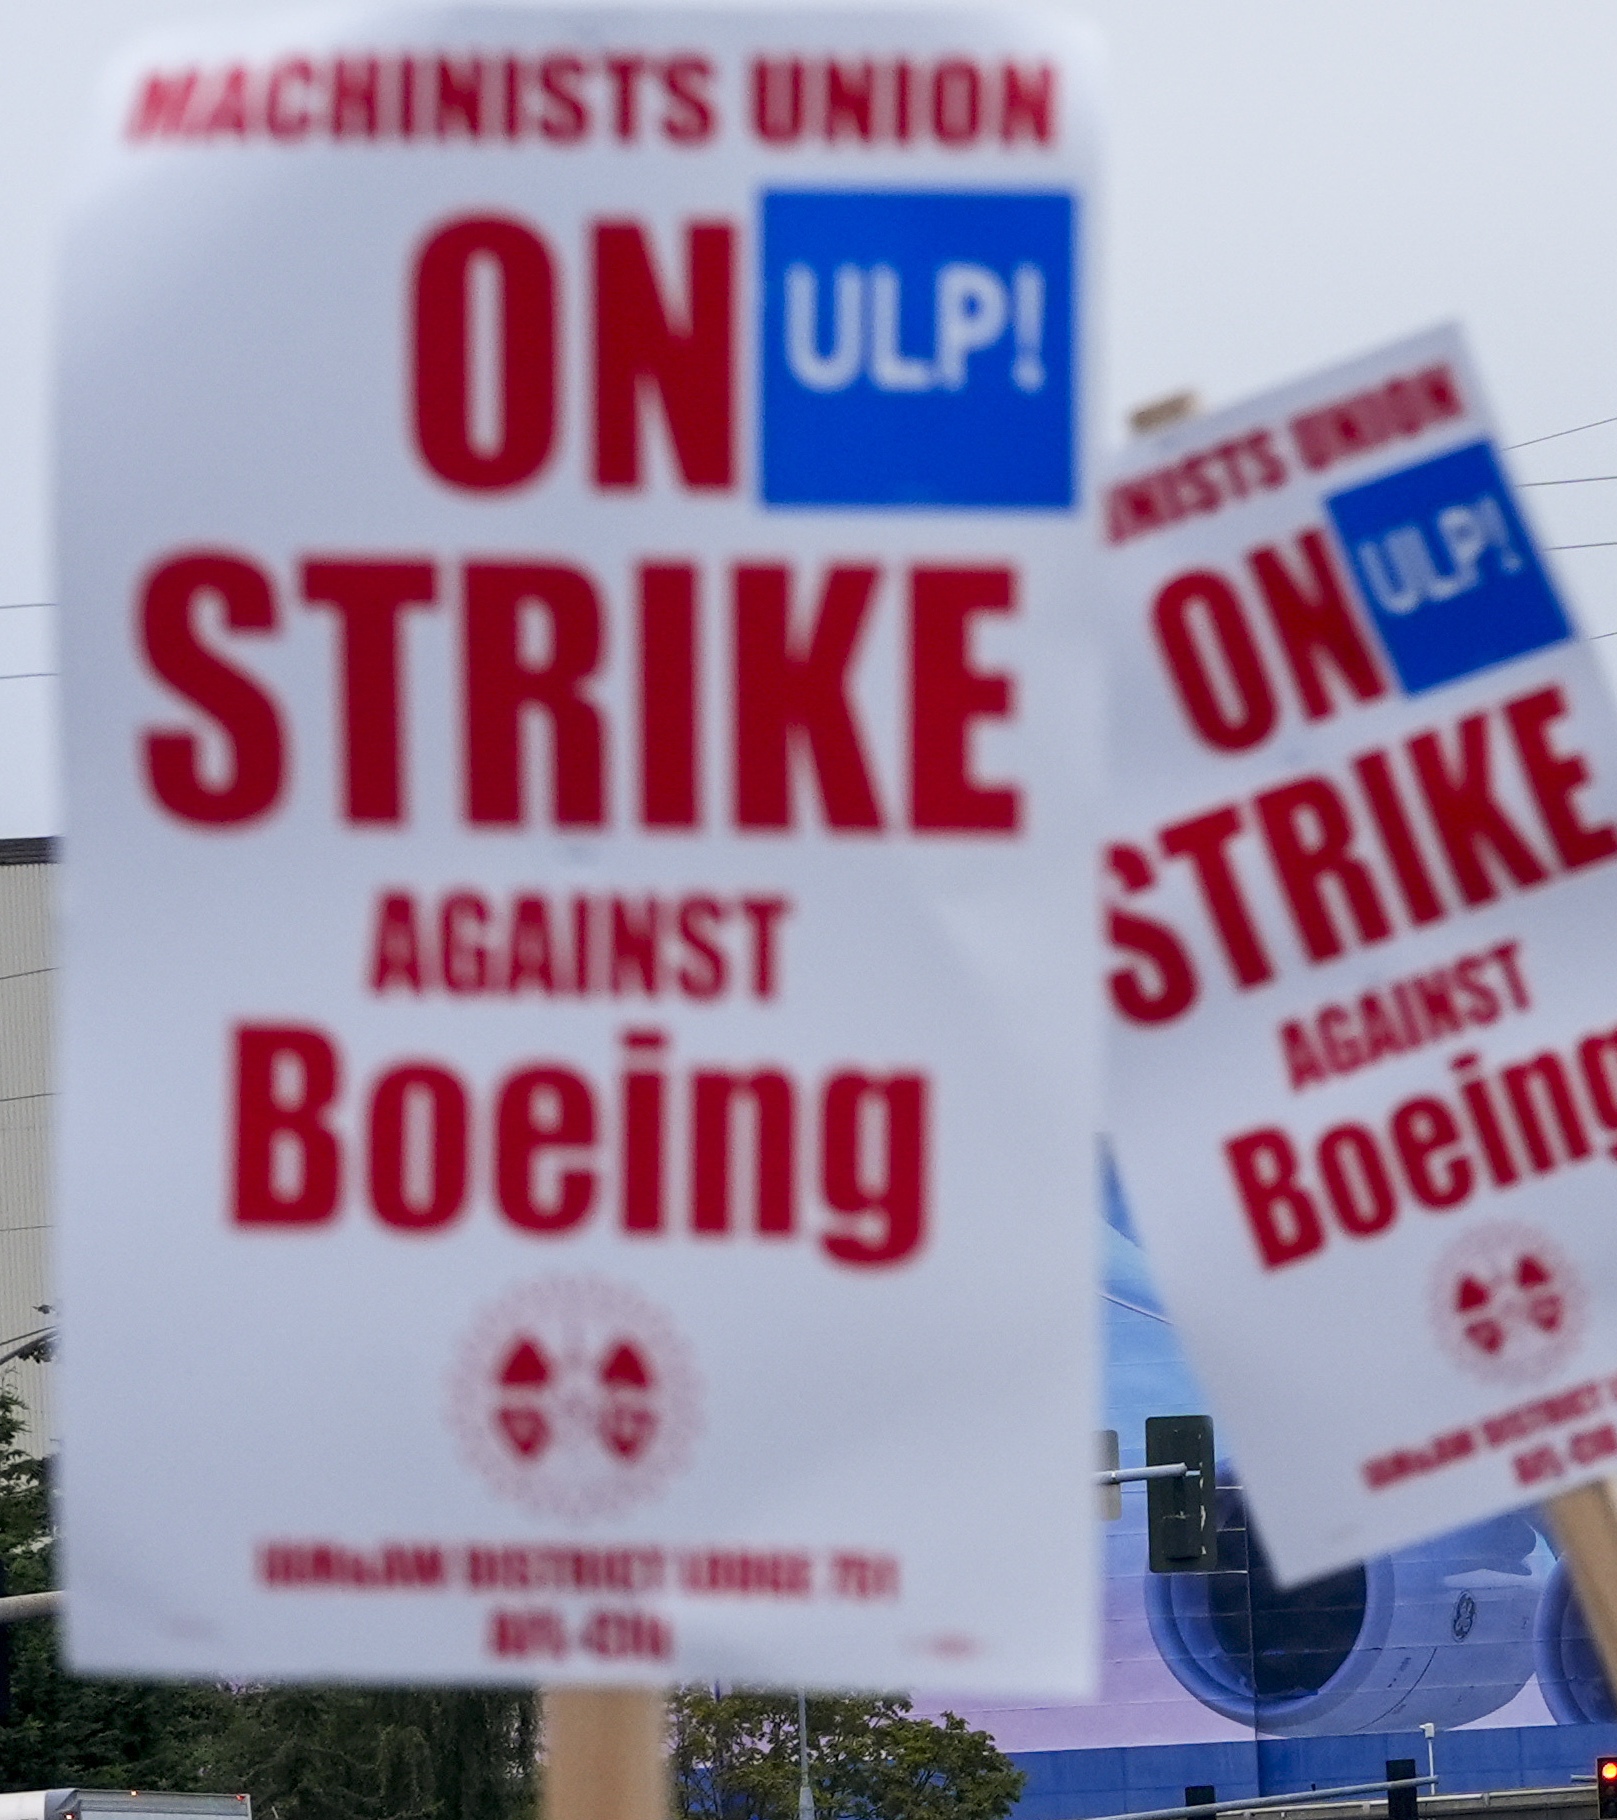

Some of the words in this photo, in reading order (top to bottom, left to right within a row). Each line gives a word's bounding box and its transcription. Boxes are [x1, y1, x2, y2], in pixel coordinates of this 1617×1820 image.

[128, 55, 718, 148] MACHINISTS
[751, 56, 1060, 149] UNION
[408, 211, 739, 495] ON
[784, 260, 1048, 394] ULP!
[1290, 363, 1465, 472] UNION
[1358, 495, 1523, 614] ULP!
[136, 547, 1024, 836] STRIKE
[1150, 524, 1388, 752] ON
[370, 888, 790, 1001] AGAINST
[1276, 943, 1531, 1090] AGAINST
[228, 1020, 932, 1270] Boeing
